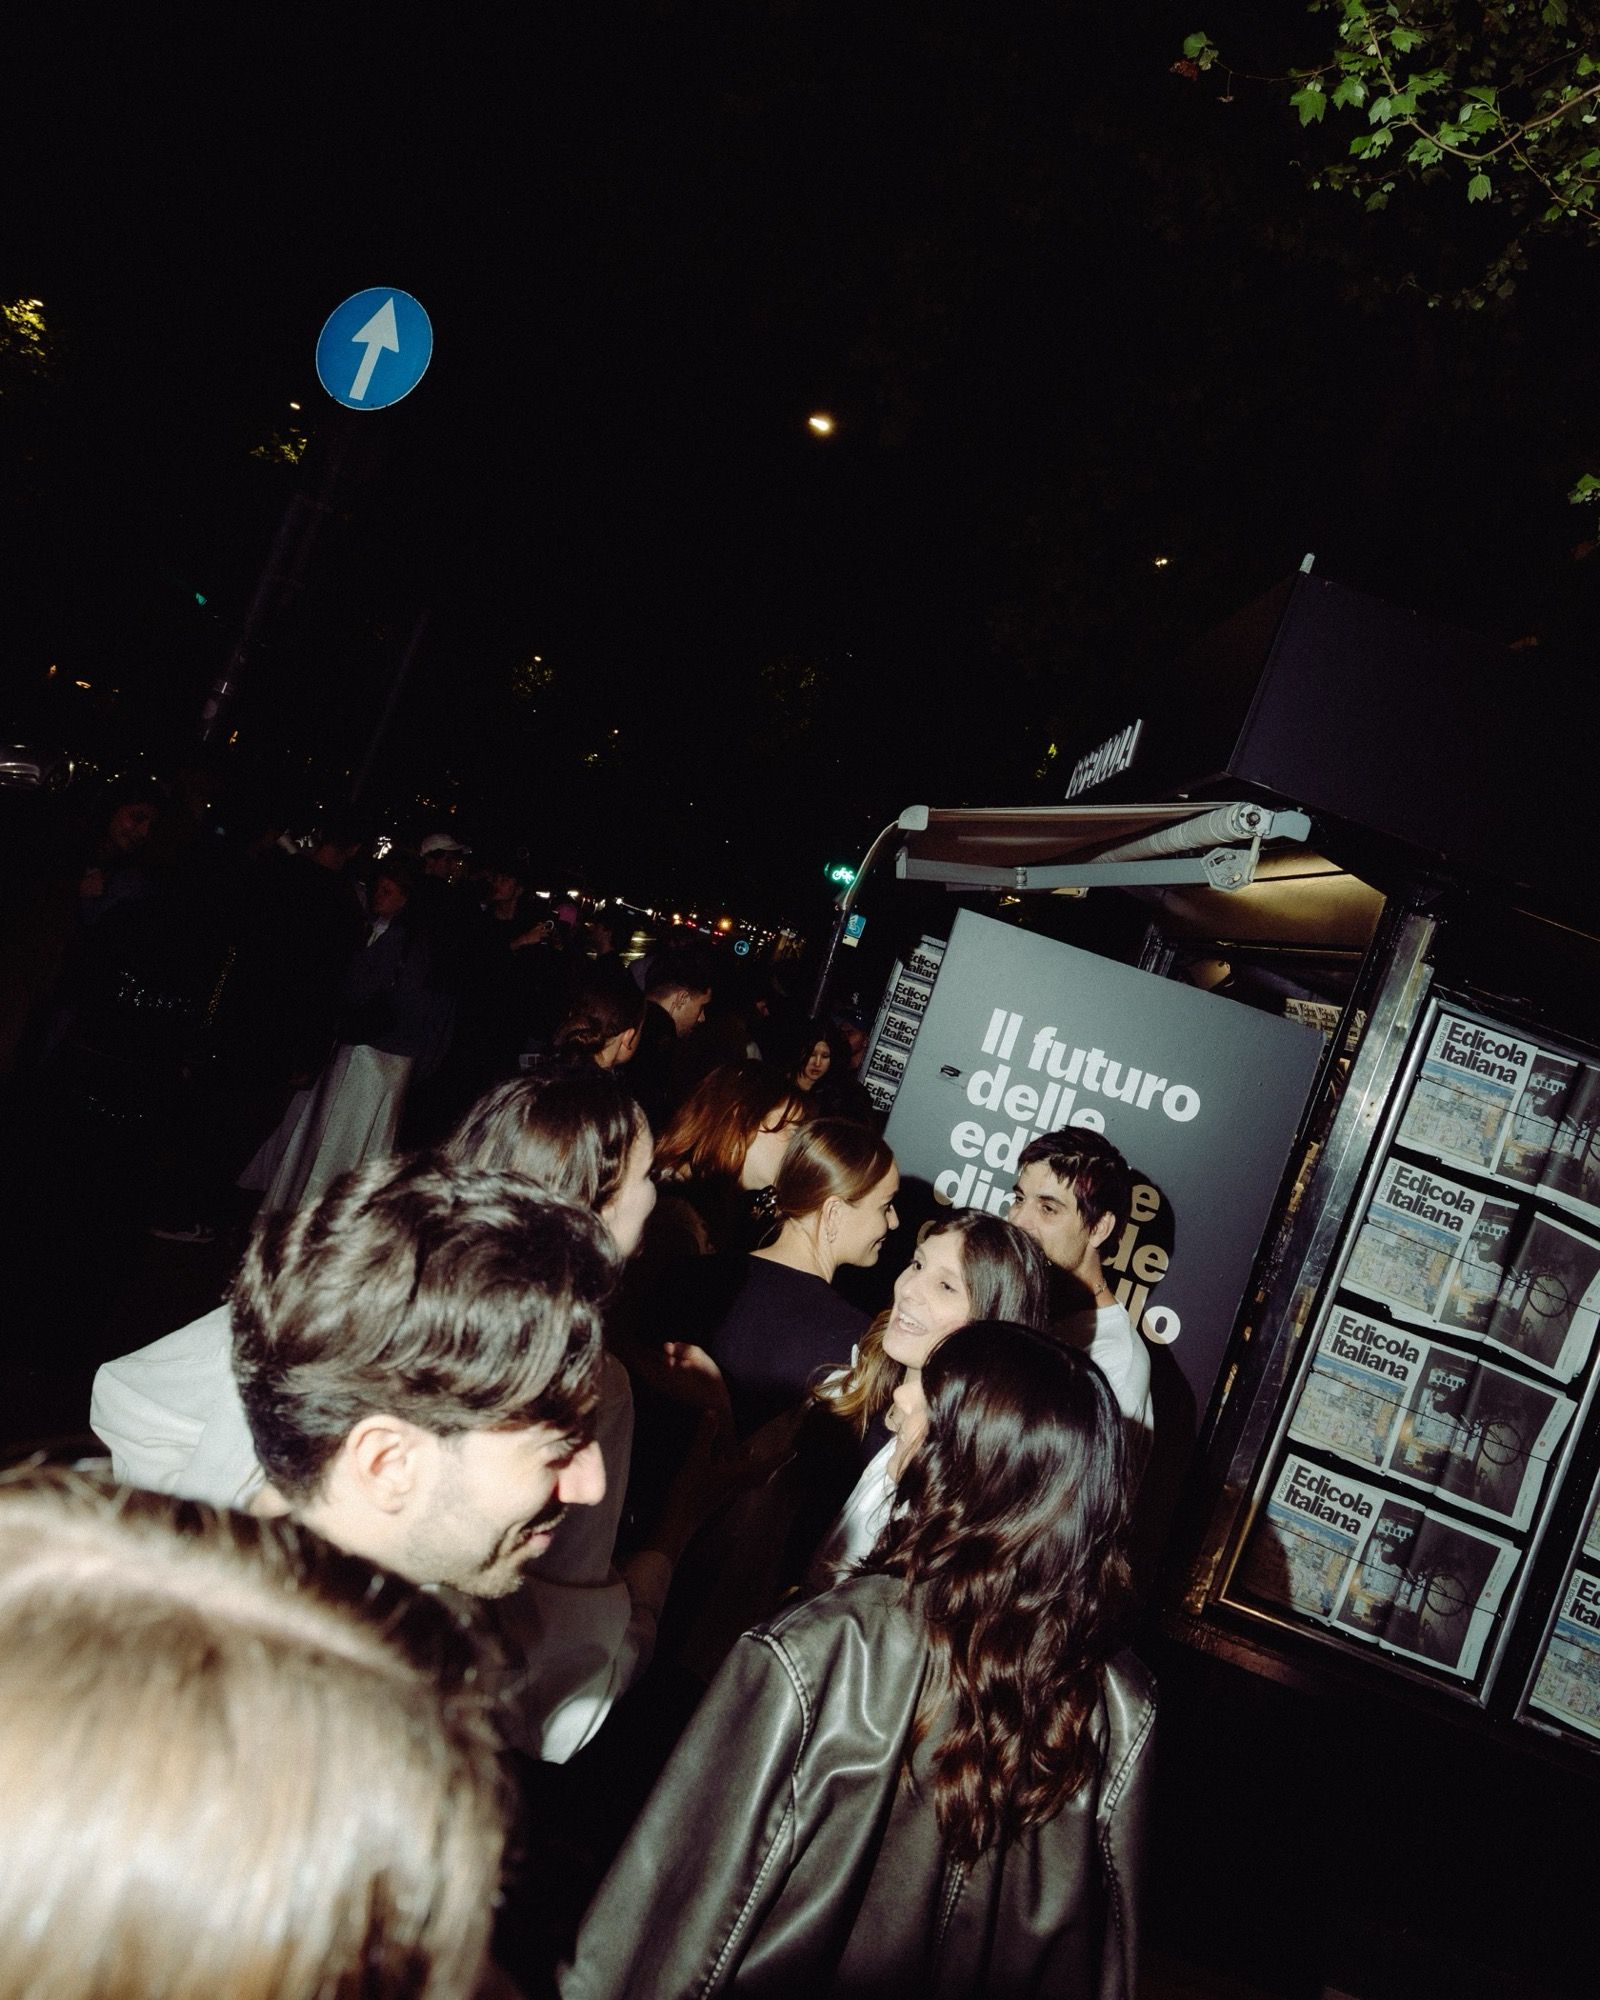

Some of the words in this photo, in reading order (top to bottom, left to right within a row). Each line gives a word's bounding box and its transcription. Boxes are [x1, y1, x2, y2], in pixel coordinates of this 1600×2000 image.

[980, 1008, 1024, 1060] Il
[1028, 1026, 1201, 1122] futuro
[1439, 1041, 1518, 1085] Italiana
[1446, 1022, 1528, 1067] Edicola
[966, 1063, 1106, 1135] delle
[1385, 1185, 1464, 1232] Italiana
[1392, 1166, 1476, 1216] Edicola
[1330, 1334, 1410, 1382] Italiana
[1337, 1314, 1421, 1364] Edicola
[1283, 1484, 1361, 1535] Italiana
[1291, 1464, 1373, 1519] Edicola
